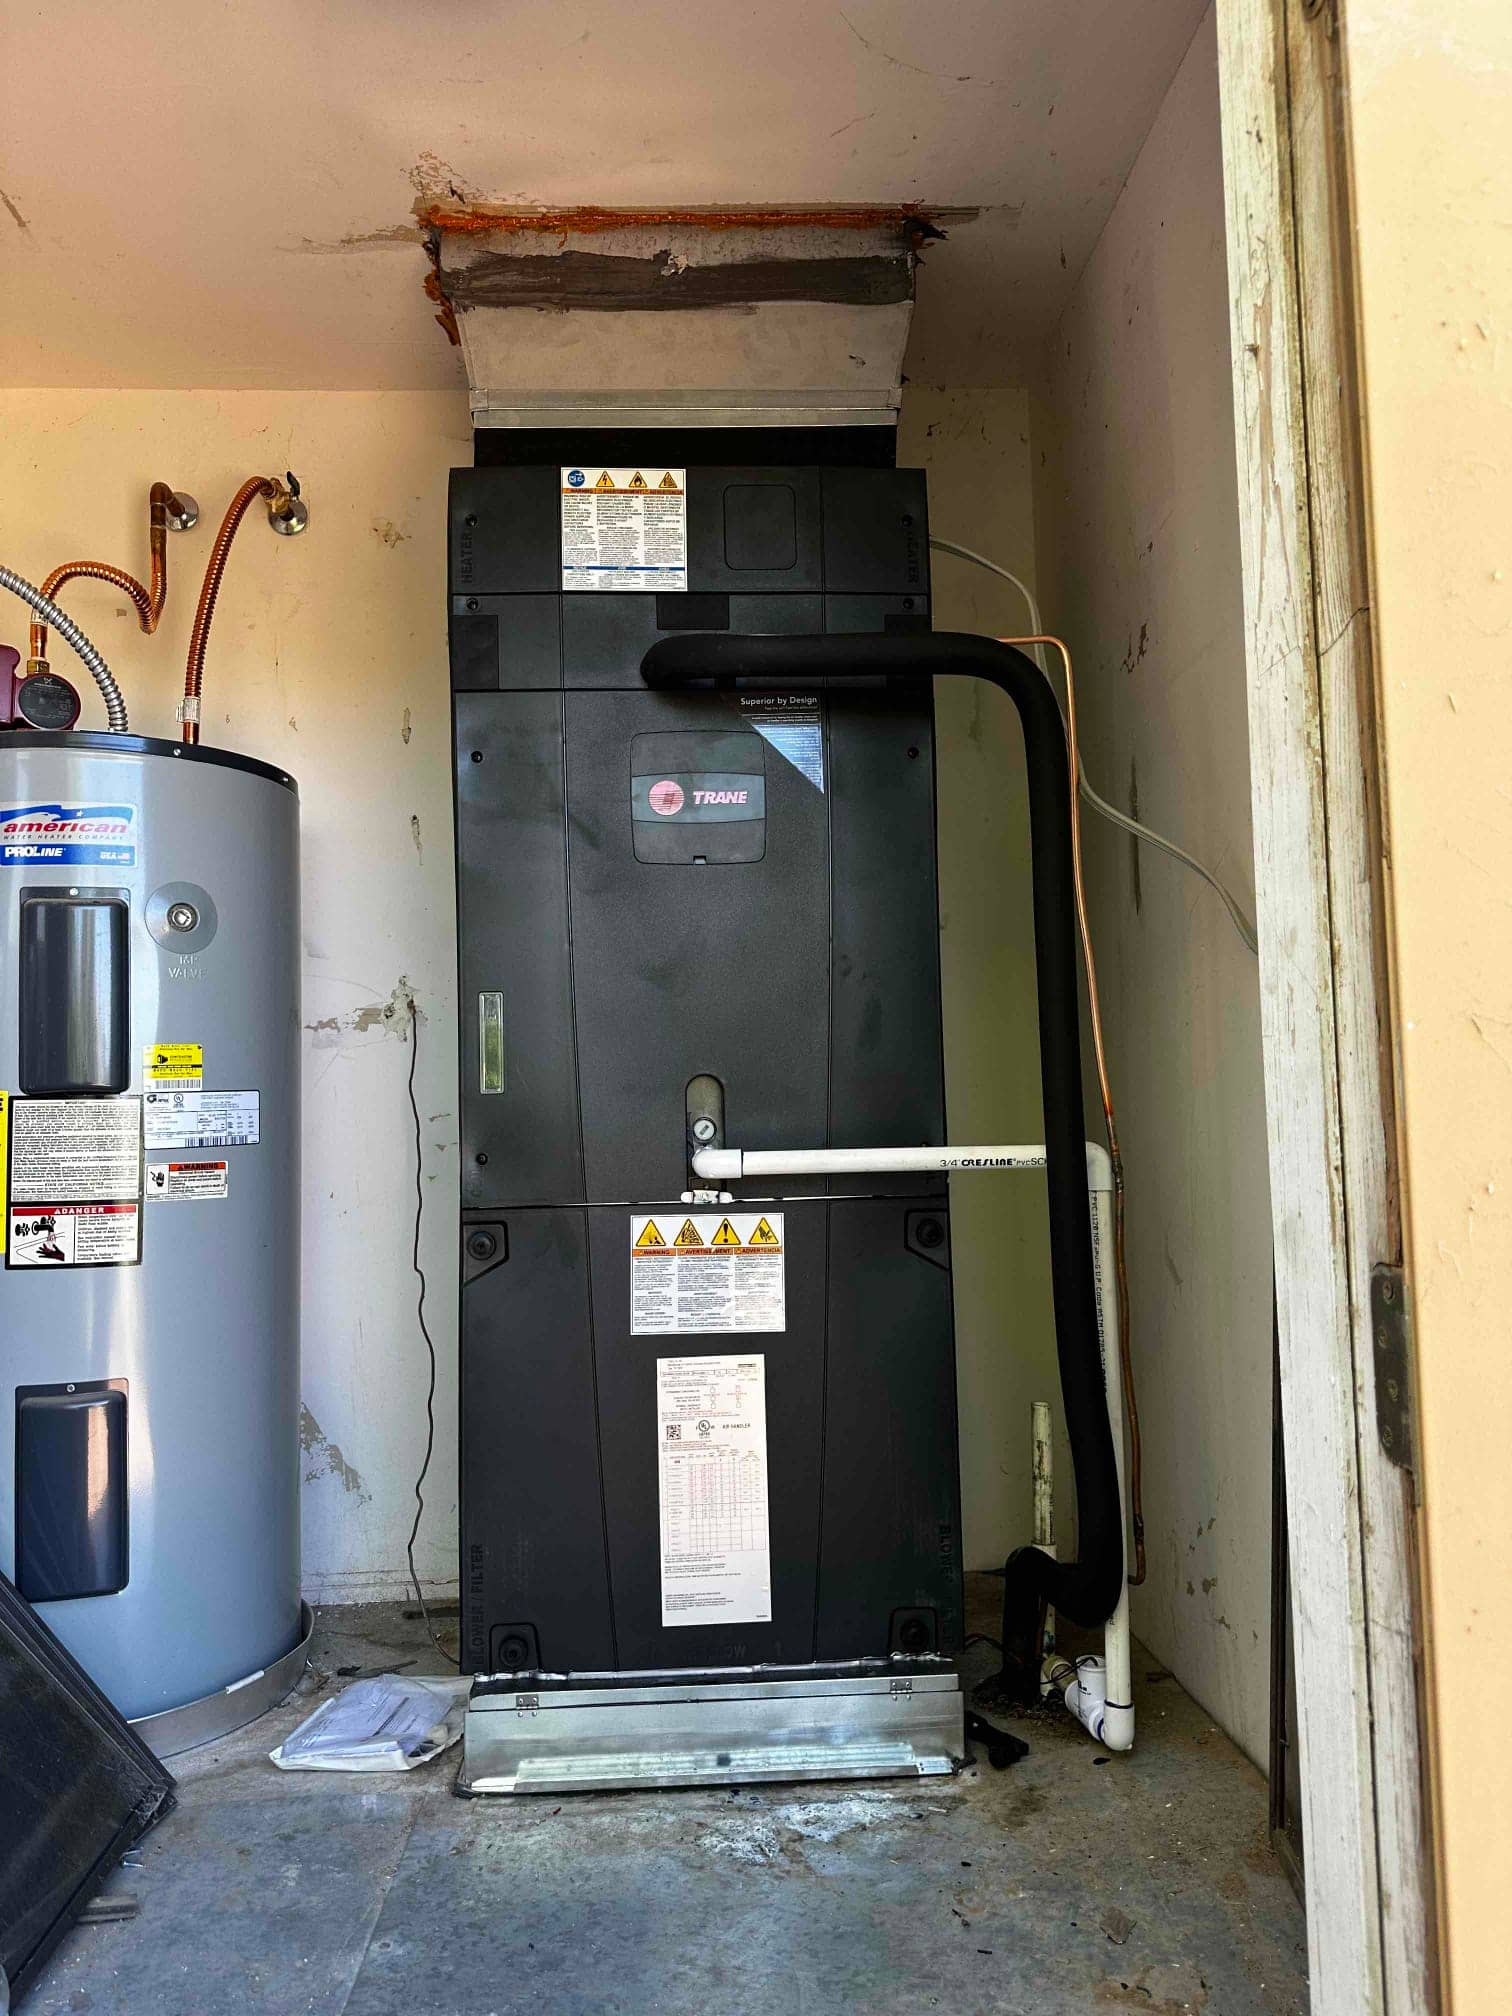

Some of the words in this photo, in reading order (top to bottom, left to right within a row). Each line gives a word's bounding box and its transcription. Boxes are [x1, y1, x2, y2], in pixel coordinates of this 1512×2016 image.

[460, 531, 472, 584] HEATER
[740, 697, 775, 707] Superior
[777, 697, 787, 706] by
[789, 696, 818, 706] Design
[692, 790, 748, 805] TRANE
[3, 822, 129, 834] american
[4, 846, 64, 858] PROLINE
[961, 1157, 1014, 1167] CRESLINE
[60, 1206, 105, 1215] DANGER
